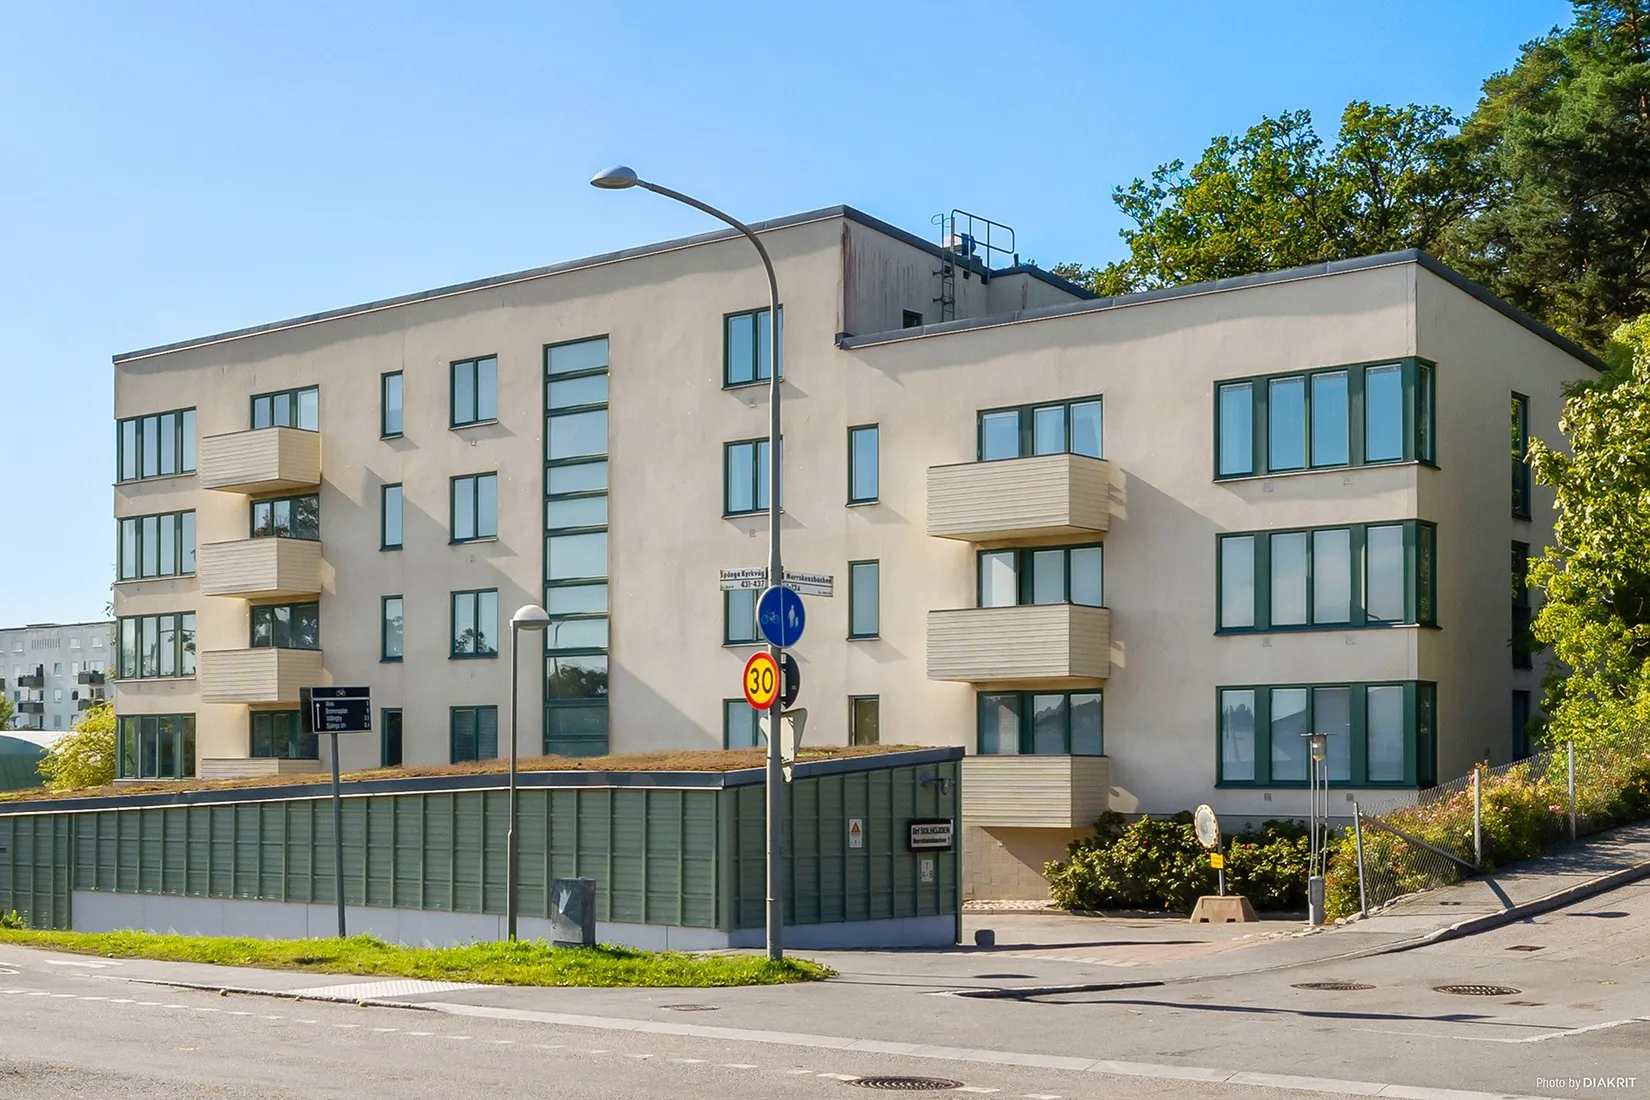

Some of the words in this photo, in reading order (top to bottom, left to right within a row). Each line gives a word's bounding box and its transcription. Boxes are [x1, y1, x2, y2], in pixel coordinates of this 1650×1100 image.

[720, 570, 740, 579] Spånga
[741, 569, 764, 579] Kyrkväg
[740, 580, 765, 588] 431-437
[750, 667, 774, 694] 30
[921, 826, 950, 835] SOLHÖJDEN
